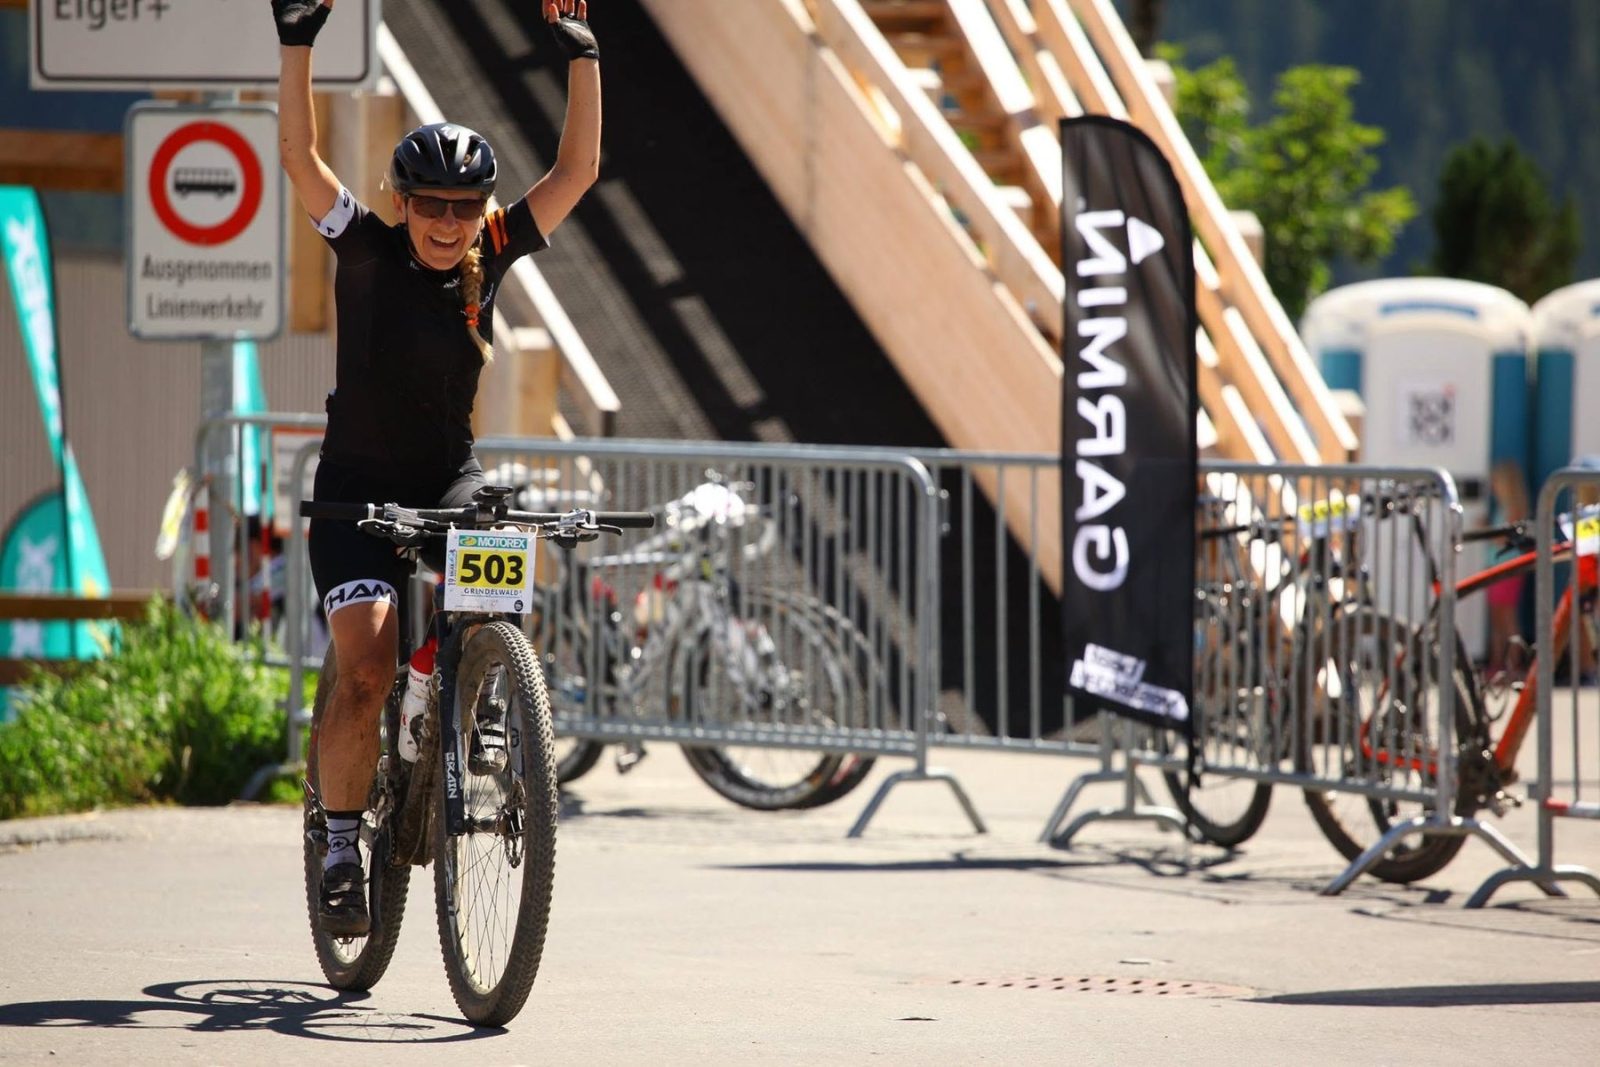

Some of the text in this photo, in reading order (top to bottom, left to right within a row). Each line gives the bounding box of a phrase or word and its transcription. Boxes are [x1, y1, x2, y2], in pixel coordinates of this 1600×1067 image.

[141, 253, 272, 287] Ausgenommen
[146, 292, 265, 320] Linienverkehr
[478, 537, 525, 548] MOTOREX
[460, 553, 523, 585] 503
[464, 588, 519, 596] GRINDELWALD
